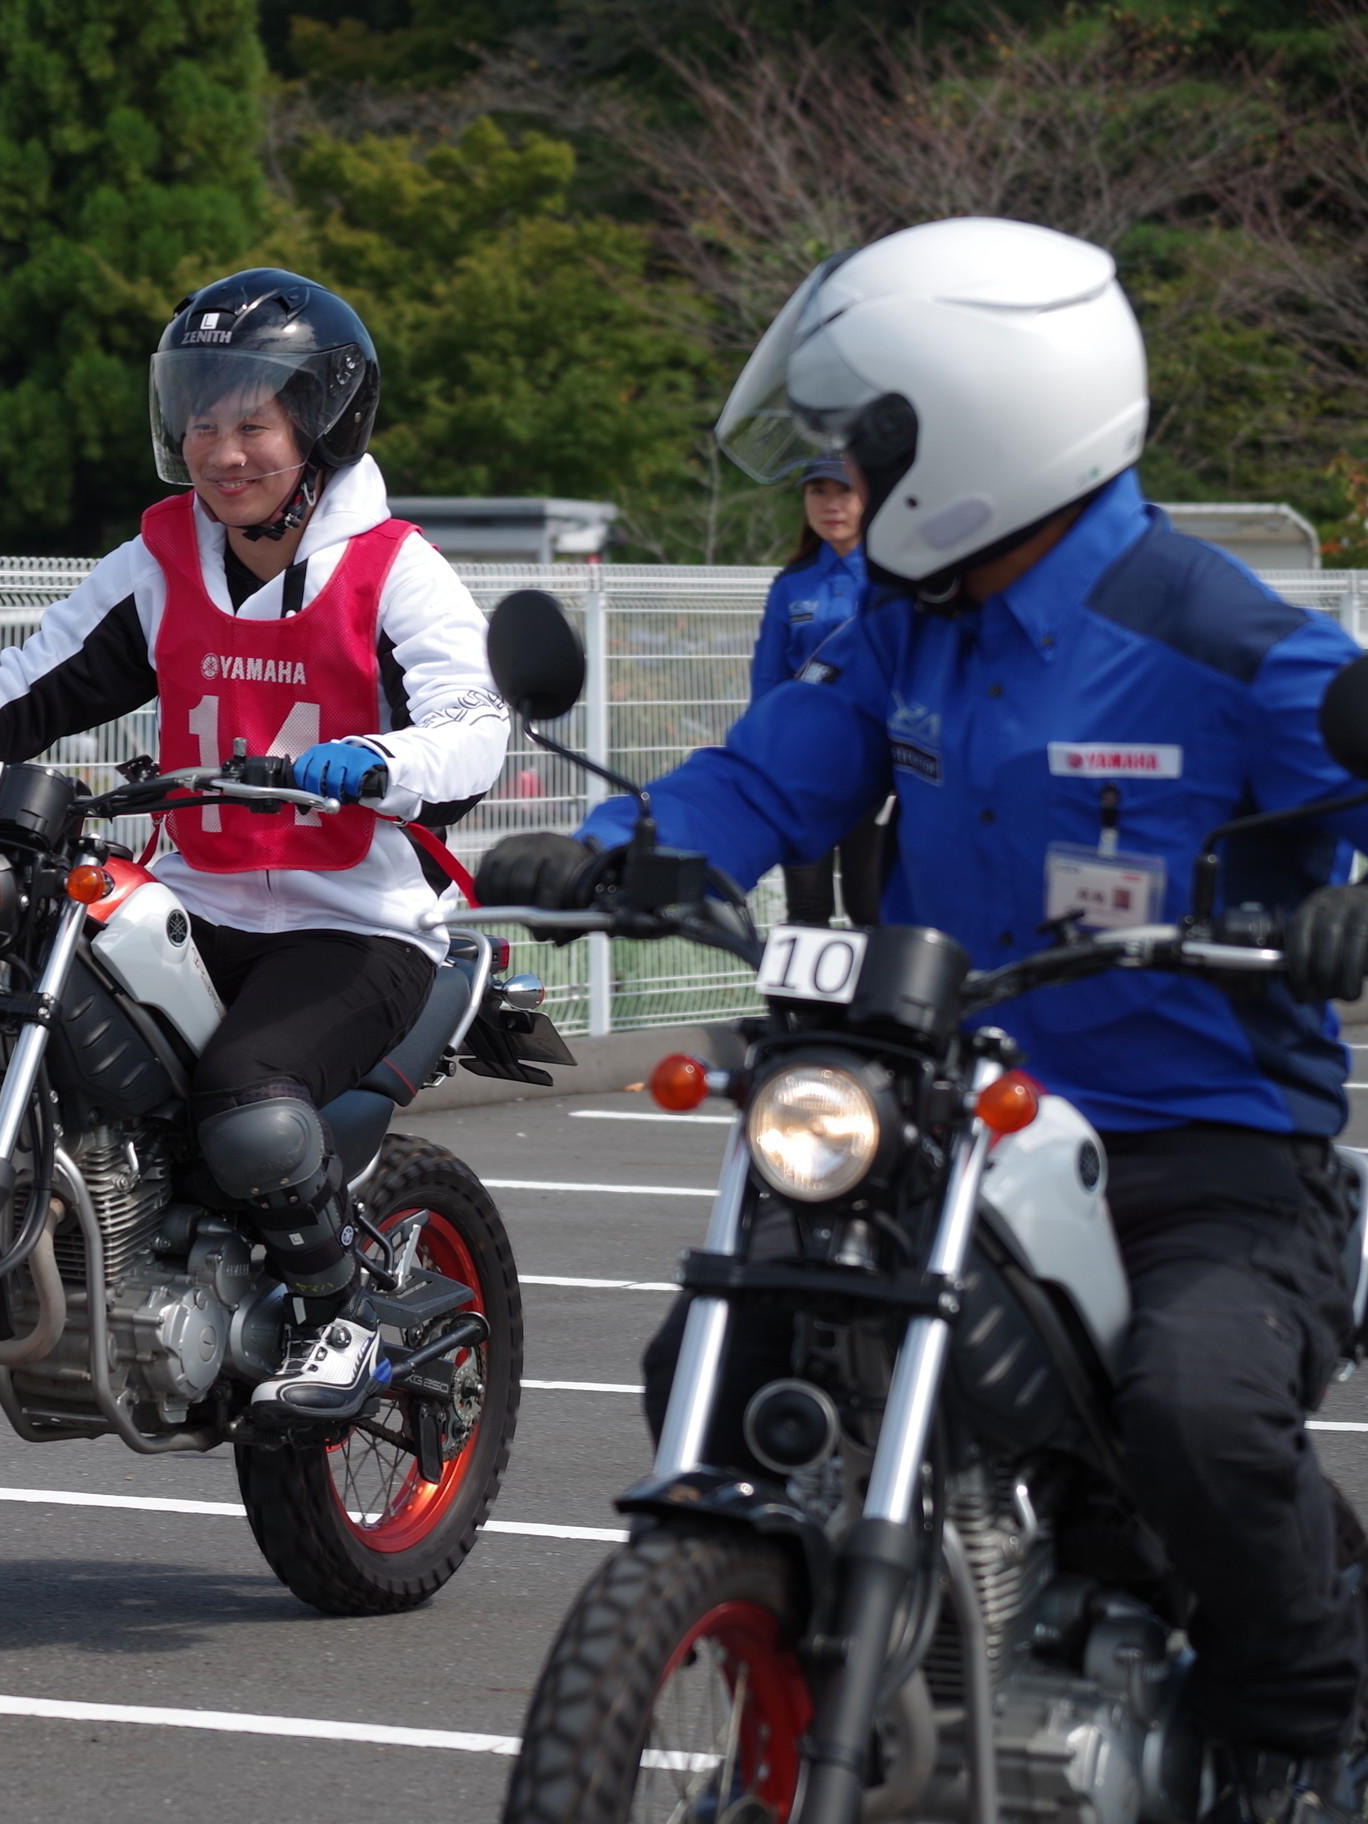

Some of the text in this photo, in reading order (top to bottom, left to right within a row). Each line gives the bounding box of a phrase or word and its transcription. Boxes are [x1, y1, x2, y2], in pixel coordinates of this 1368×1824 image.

[181, 330, 232, 345] ZENITH
[219, 656, 307, 685] YAMAHA
[1087, 751, 1159, 772] YAMAHA
[767, 936, 855, 993] 10
